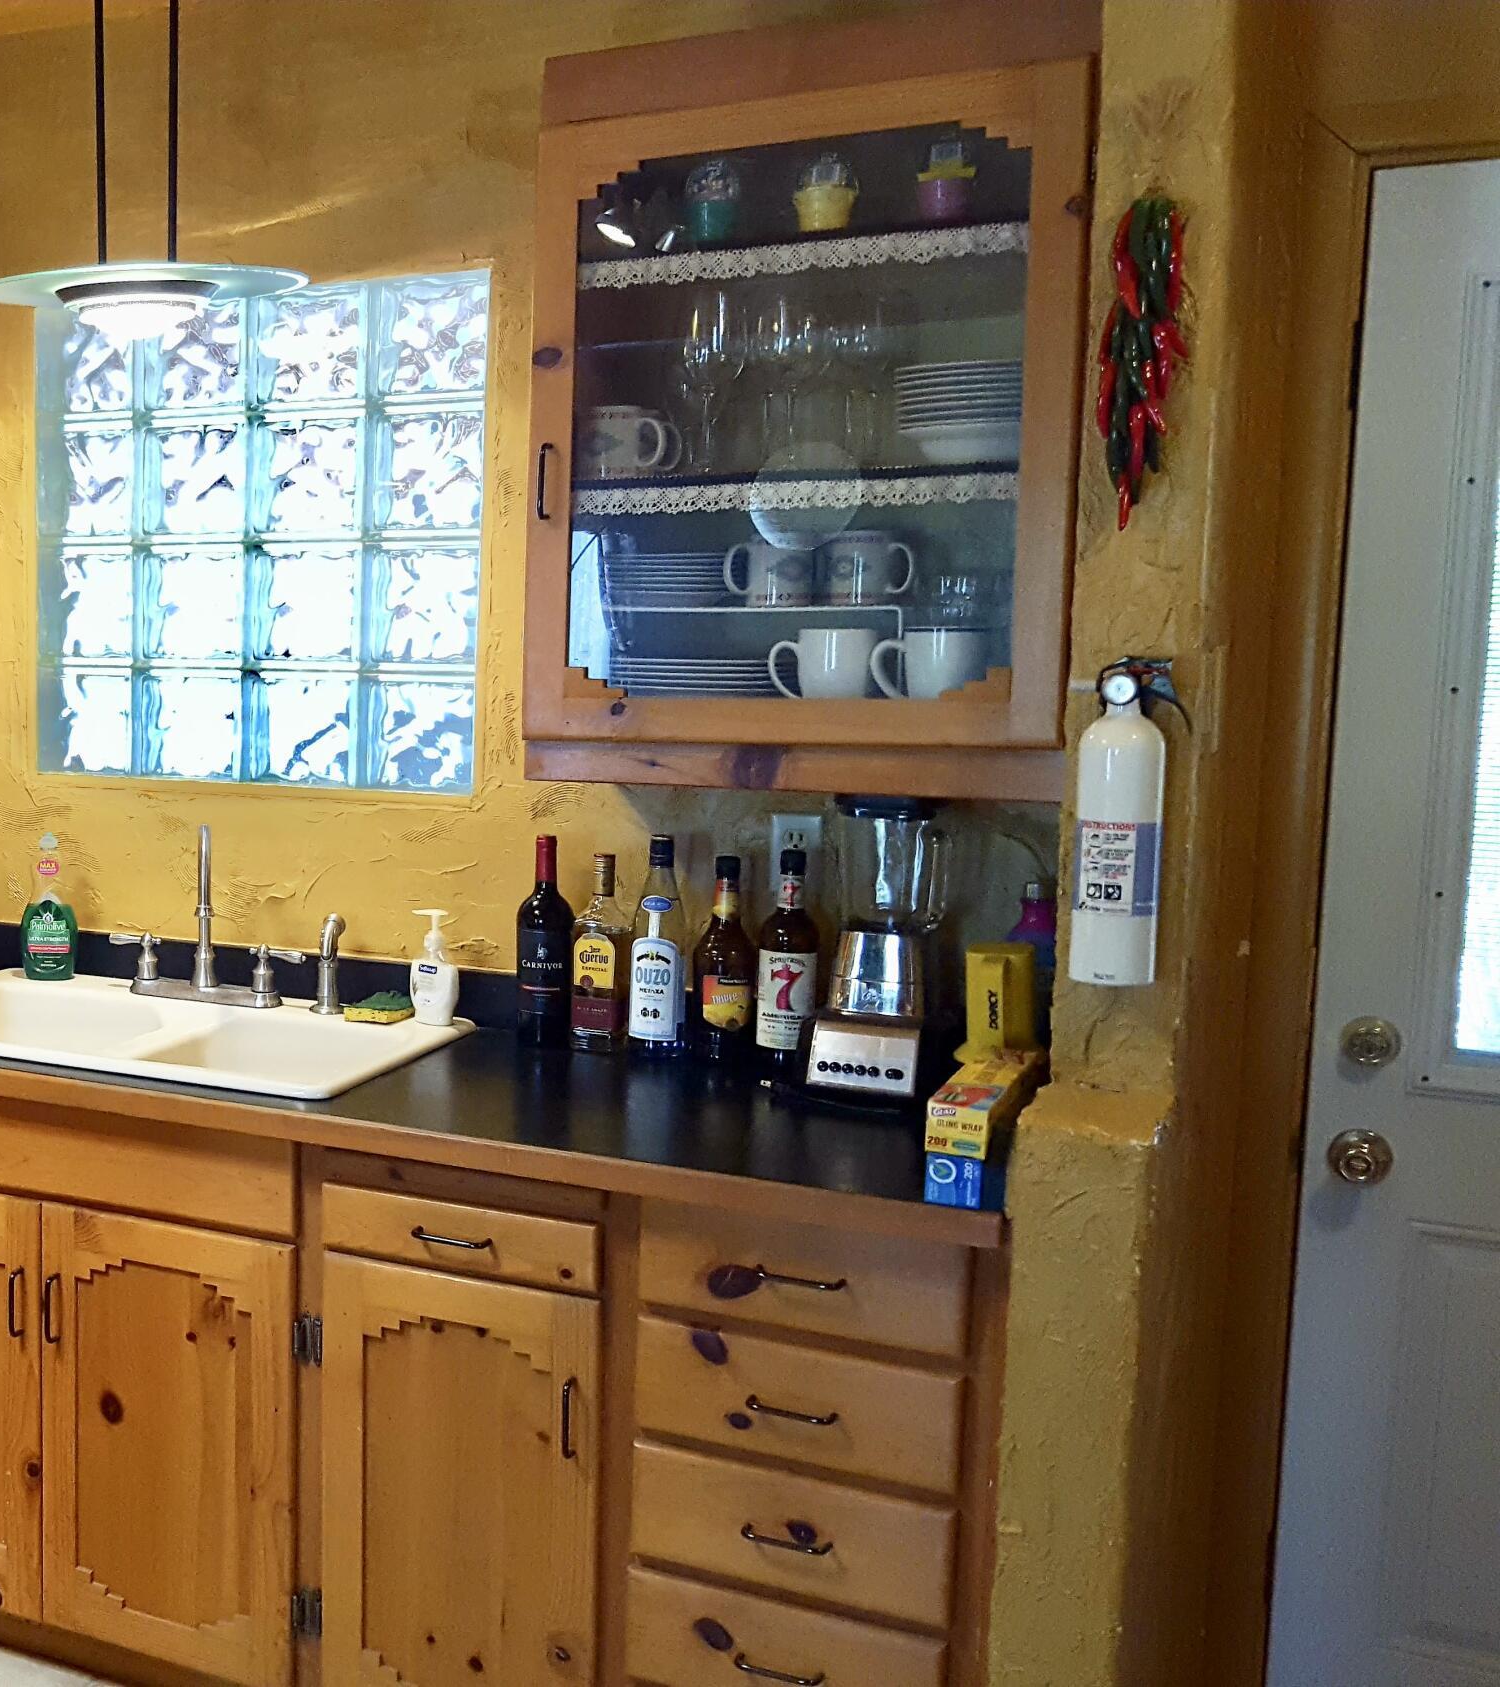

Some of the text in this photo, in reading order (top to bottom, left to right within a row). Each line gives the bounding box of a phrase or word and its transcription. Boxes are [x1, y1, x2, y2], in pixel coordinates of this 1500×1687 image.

[31, 920, 67, 931] Palmolive
[521, 959, 563, 971] CARNIVOR
[579, 950, 609, 965] Cuervo
[634, 966, 671, 986] OUZO
[770, 964, 804, 1012] 7
[987, 988, 999, 1030] DORCY
[926, 1135, 948, 1147] 200
